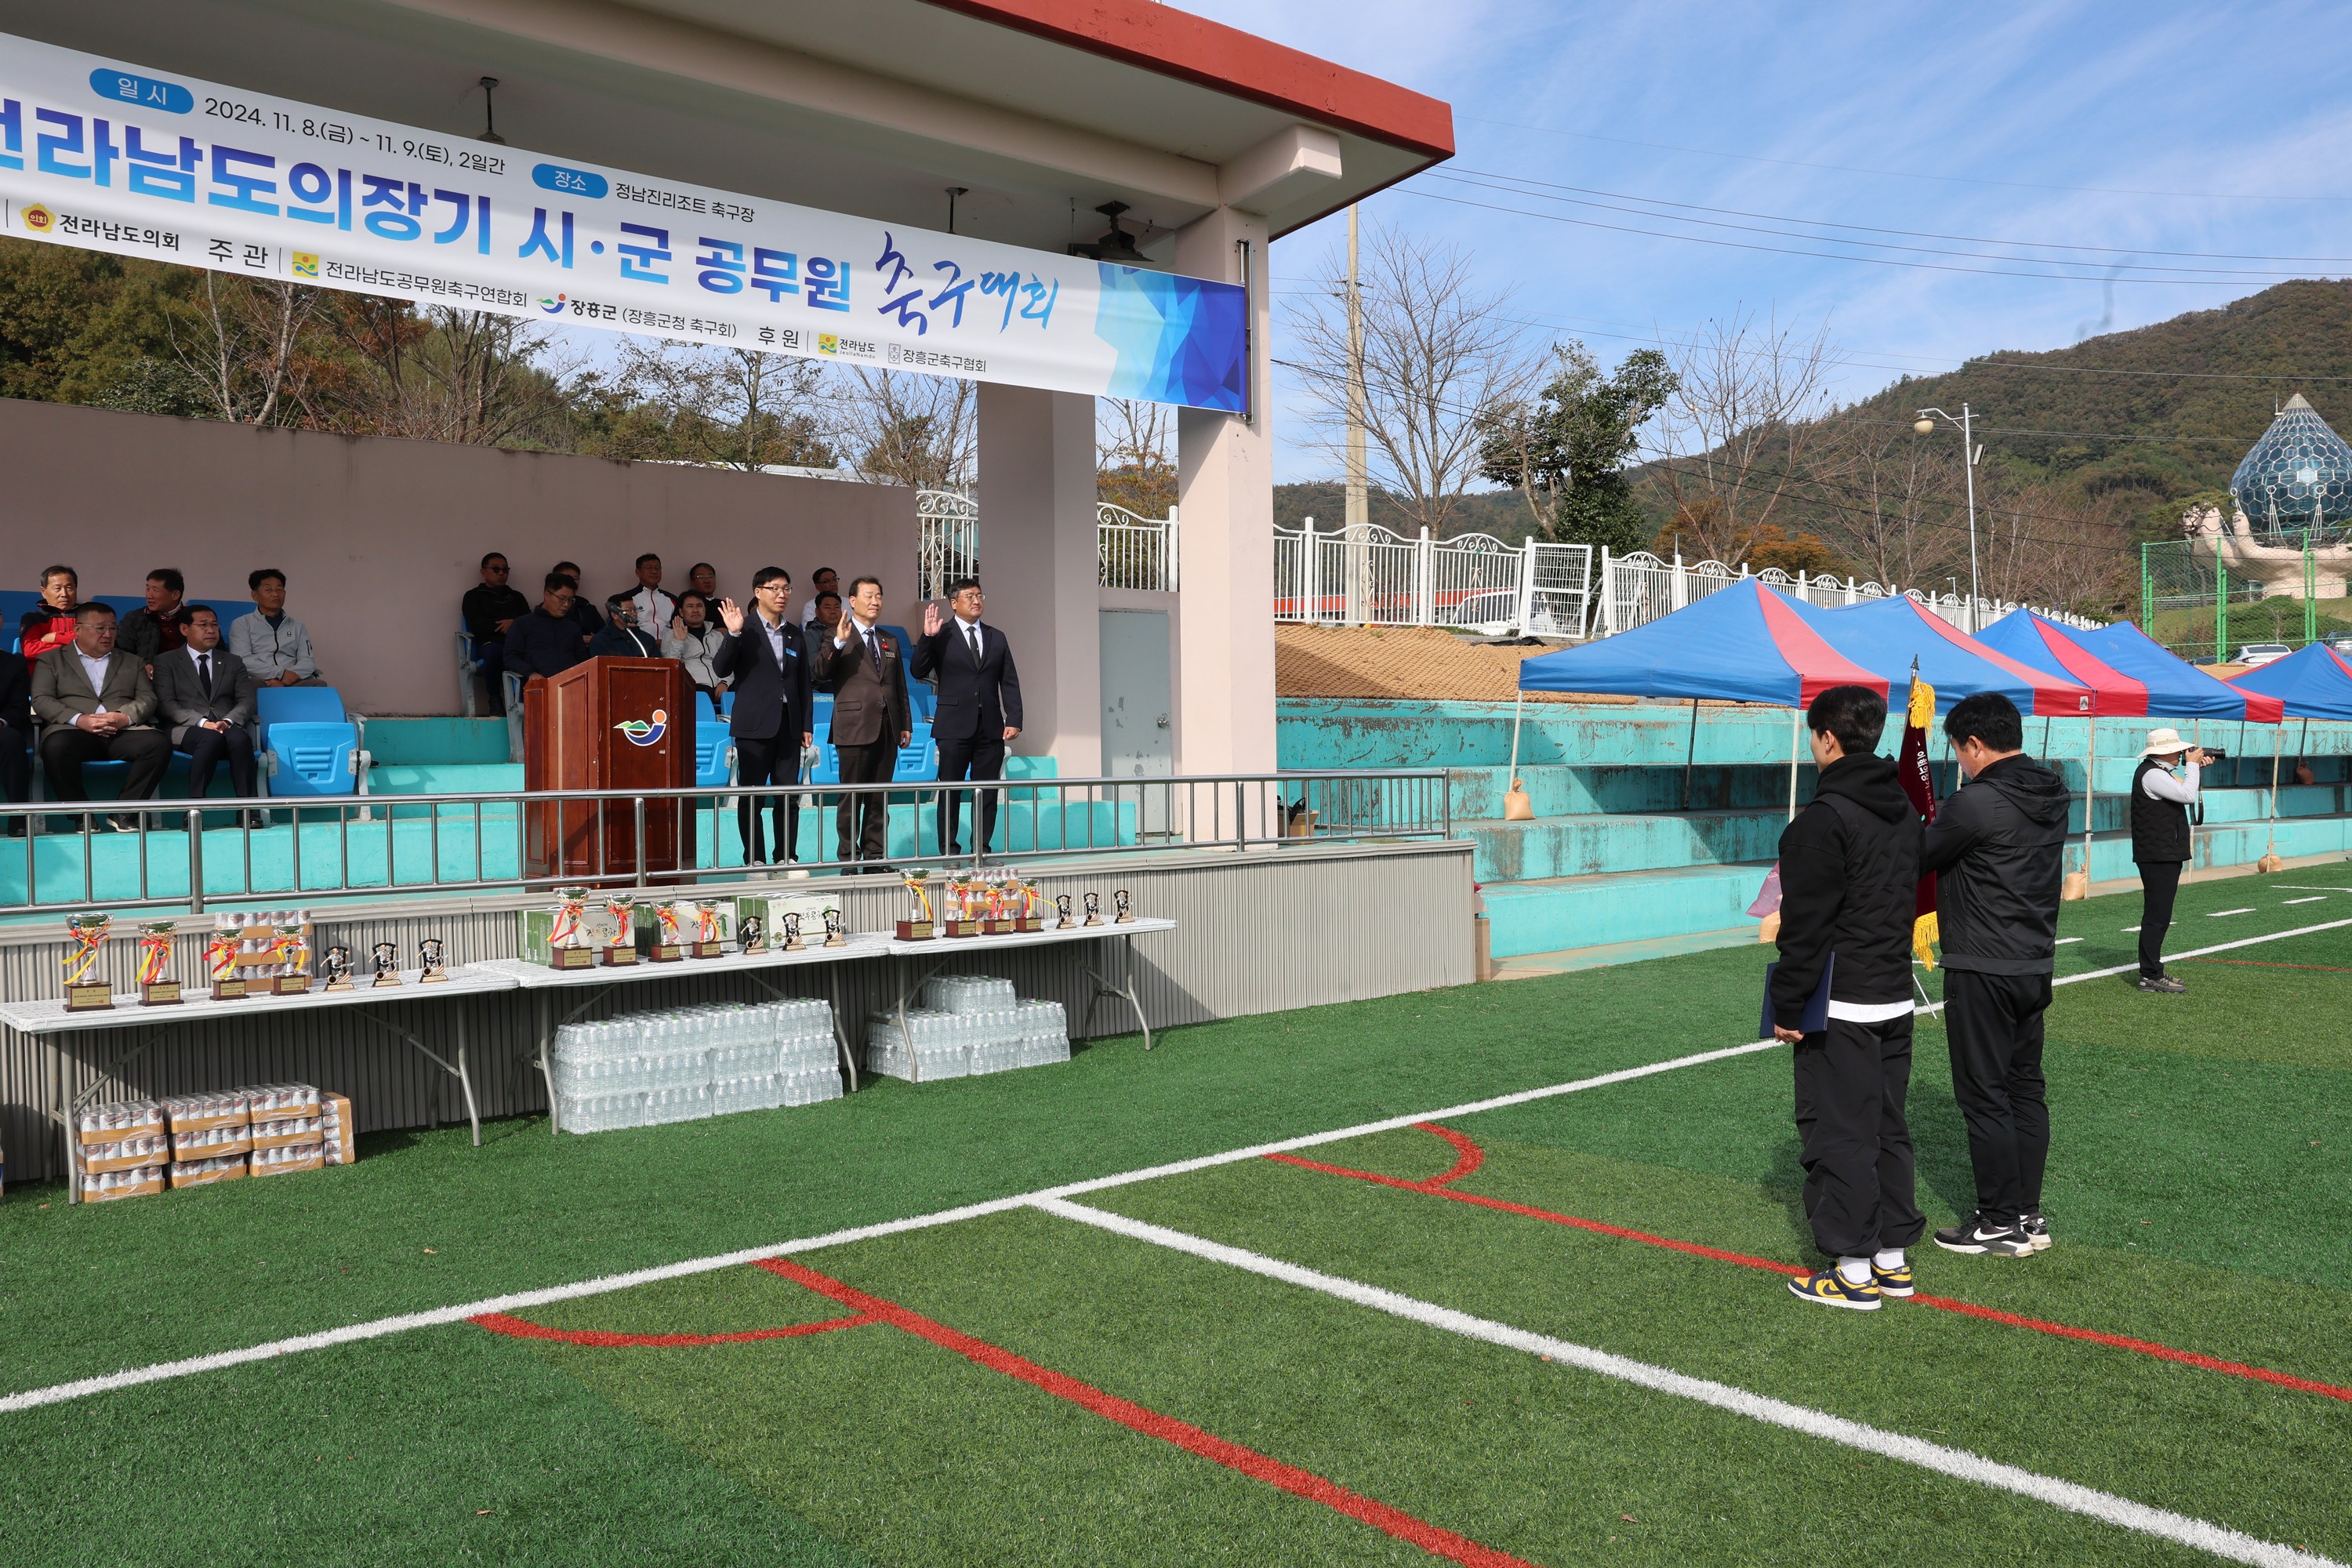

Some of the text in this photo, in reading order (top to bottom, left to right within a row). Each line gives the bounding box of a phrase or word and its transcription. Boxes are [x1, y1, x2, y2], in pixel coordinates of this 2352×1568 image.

[205, 98, 267, 126] 2024.
[274, 112, 296, 132] 11.
[303, 119, 354, 145] 8.(금)
[376, 134, 397, 154] 11.
[404, 140, 453, 167] 9.(토),
[459, 152, 506, 175] 2일간
[554, 171, 586, 191] 장소
[0, 98, 491, 256] 라남도의장기
[696, 237, 851, 313] 공무원
[876, 231, 1058, 335] 축구대회
[29, 214, 47, 225] 의회
[616, 183, 756, 223] 정남진리조트 축구장
[60, 215, 180, 251] 전라남도의회
[327, 262, 527, 307] 전라남도공무원축구연합회
[572, 300, 737, 339] 장흥군 (장흥군청 축구회)
[839, 338, 876, 353] 전라남도
[839, 350, 877, 360] JeollaNamdo
[903, 349, 986, 372] 장흥군축구협회
